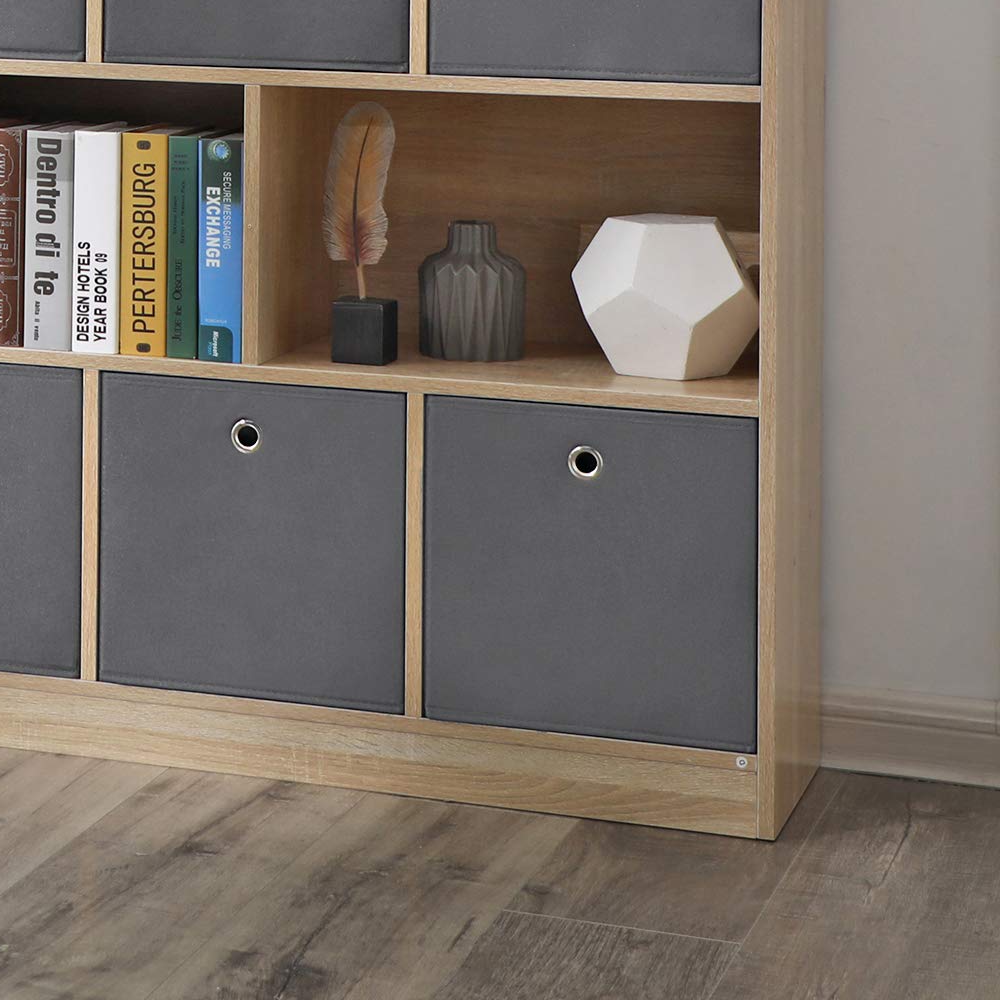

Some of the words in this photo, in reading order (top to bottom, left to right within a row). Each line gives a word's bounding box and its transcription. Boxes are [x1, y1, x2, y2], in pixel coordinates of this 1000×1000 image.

[36, 138, 62, 224] Dentro
[222, 171, 232, 203] SECURE
[35, 233, 60, 258] di
[132, 163, 155, 333] PERTERSBURG
[206, 186, 221, 267] EXCHANGE
[222, 204, 232, 250] MESSAGING
[33, 271, 59, 295] te
[77, 241, 91, 292] HOTELS
[94, 268, 107, 303] BOOK
[76, 296, 90, 342] DESIGN
[93, 308, 107, 342] YEAR
